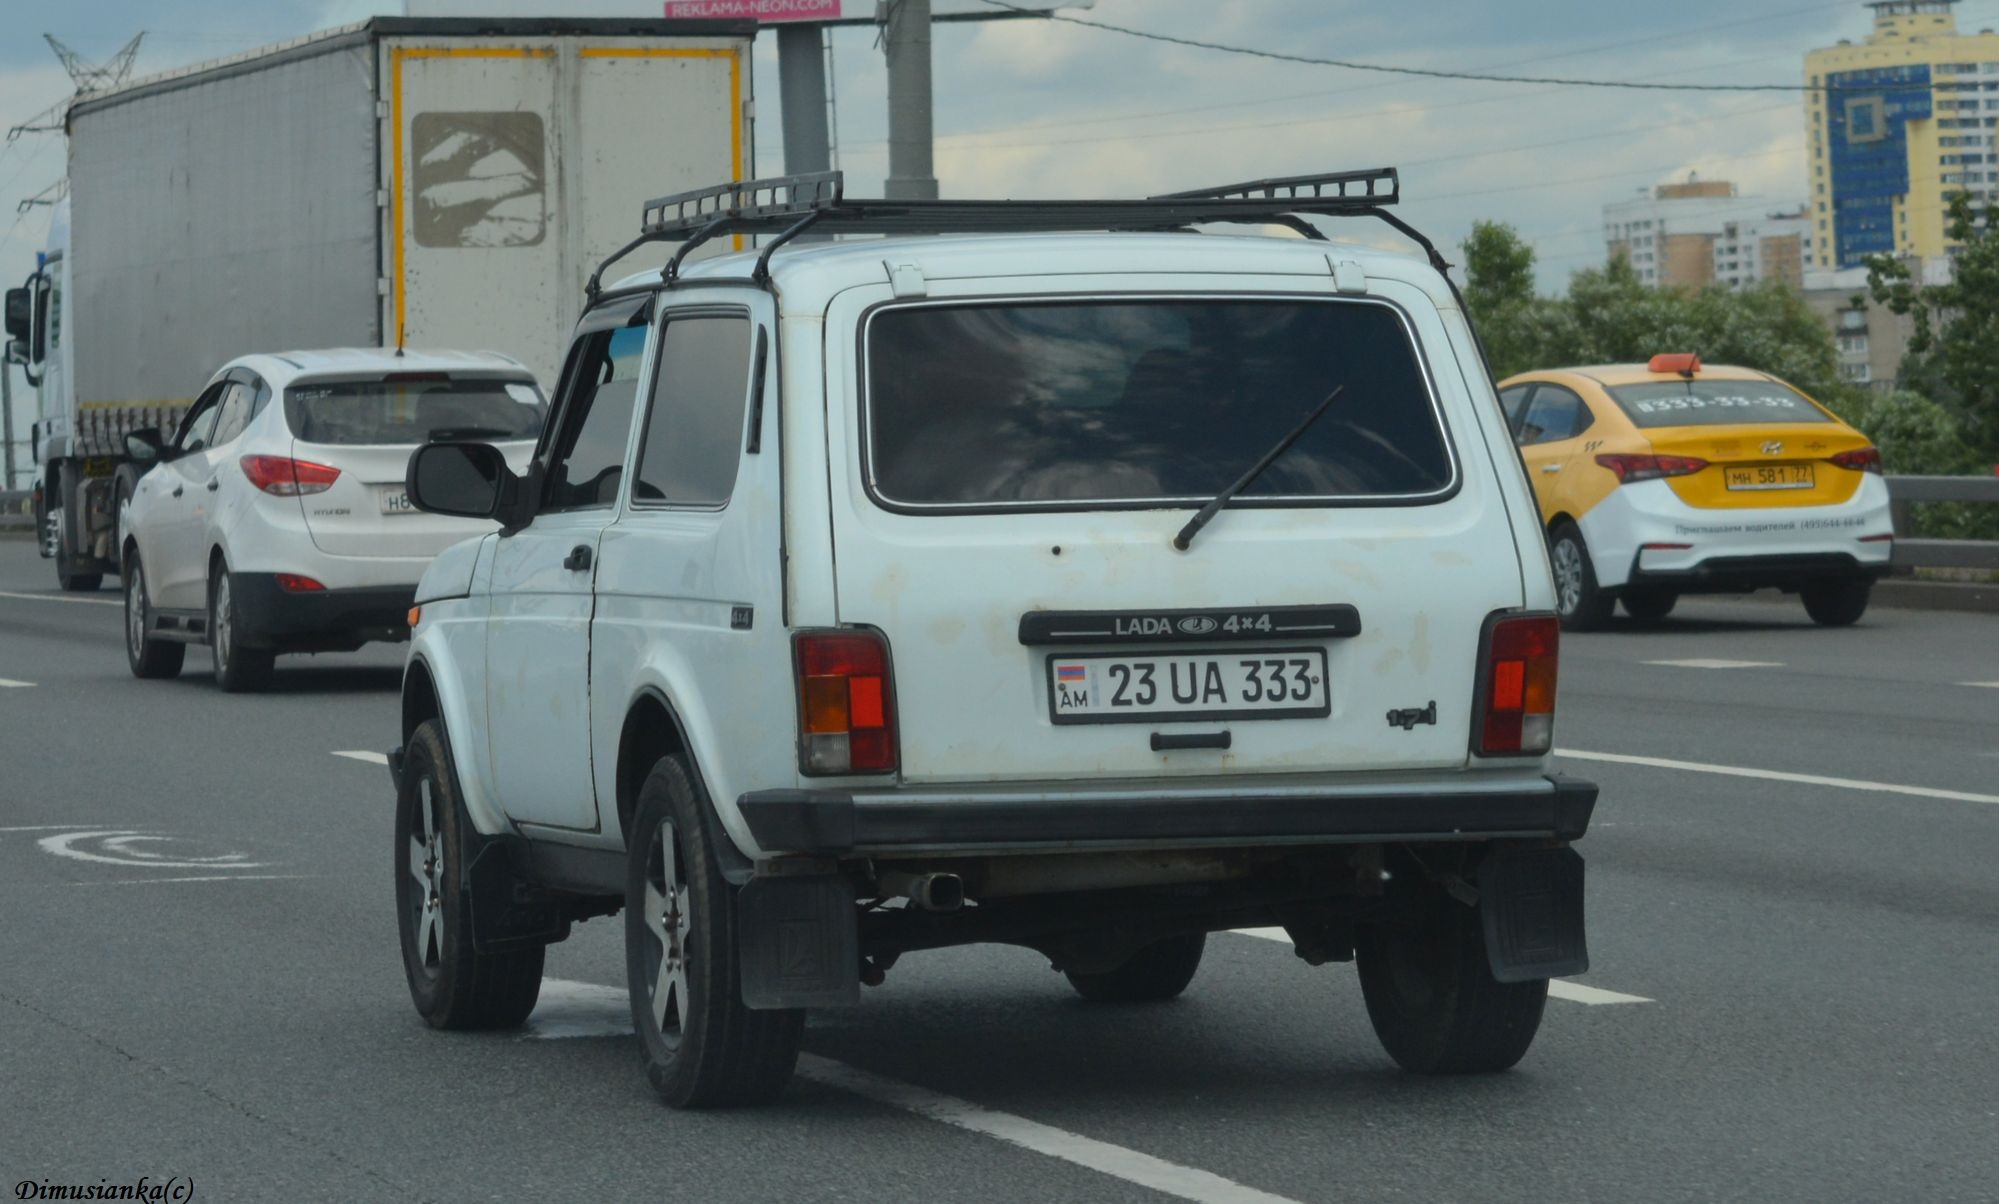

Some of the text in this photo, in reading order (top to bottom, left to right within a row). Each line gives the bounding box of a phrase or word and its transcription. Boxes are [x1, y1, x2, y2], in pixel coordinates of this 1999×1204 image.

[671, 0, 833, 18] REKLAMA-NEON.COM
[1758, 468, 1785, 484] 581
[1115, 618, 1173, 635] LADA
[1109, 659, 1312, 706] 23 UA 333
[1060, 690, 1089, 708] AM
